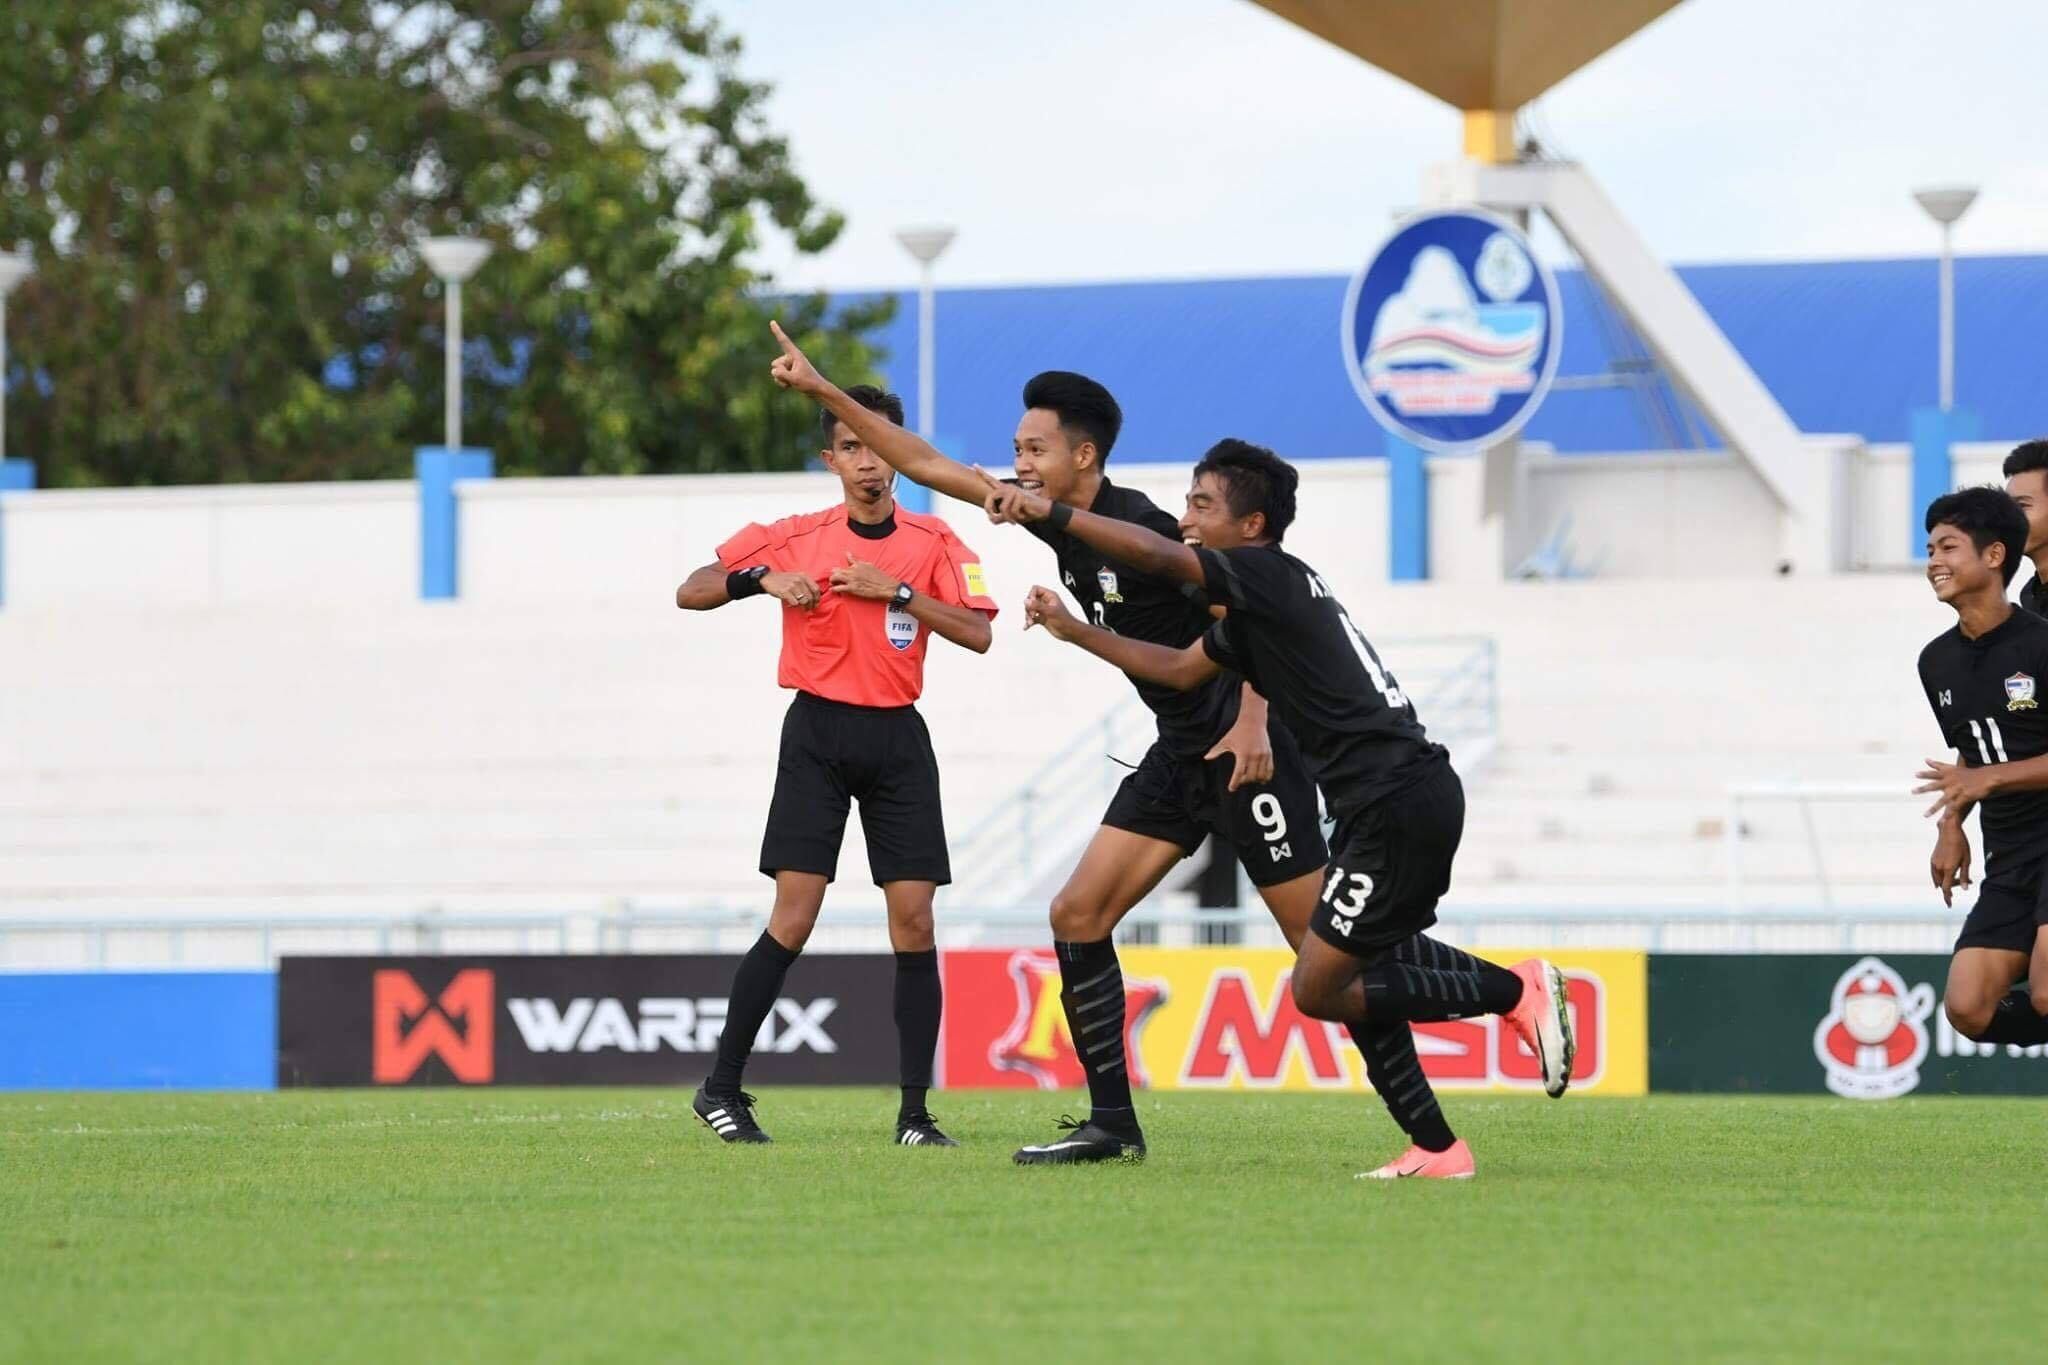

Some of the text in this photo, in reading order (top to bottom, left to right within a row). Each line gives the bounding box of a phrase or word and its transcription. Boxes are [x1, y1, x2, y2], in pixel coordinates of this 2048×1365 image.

[891, 622, 913, 632] FIFA
[1968, 717, 2009, 765] 11
[1251, 792, 1288, 842] 9
[1321, 866, 1374, 919] 13
